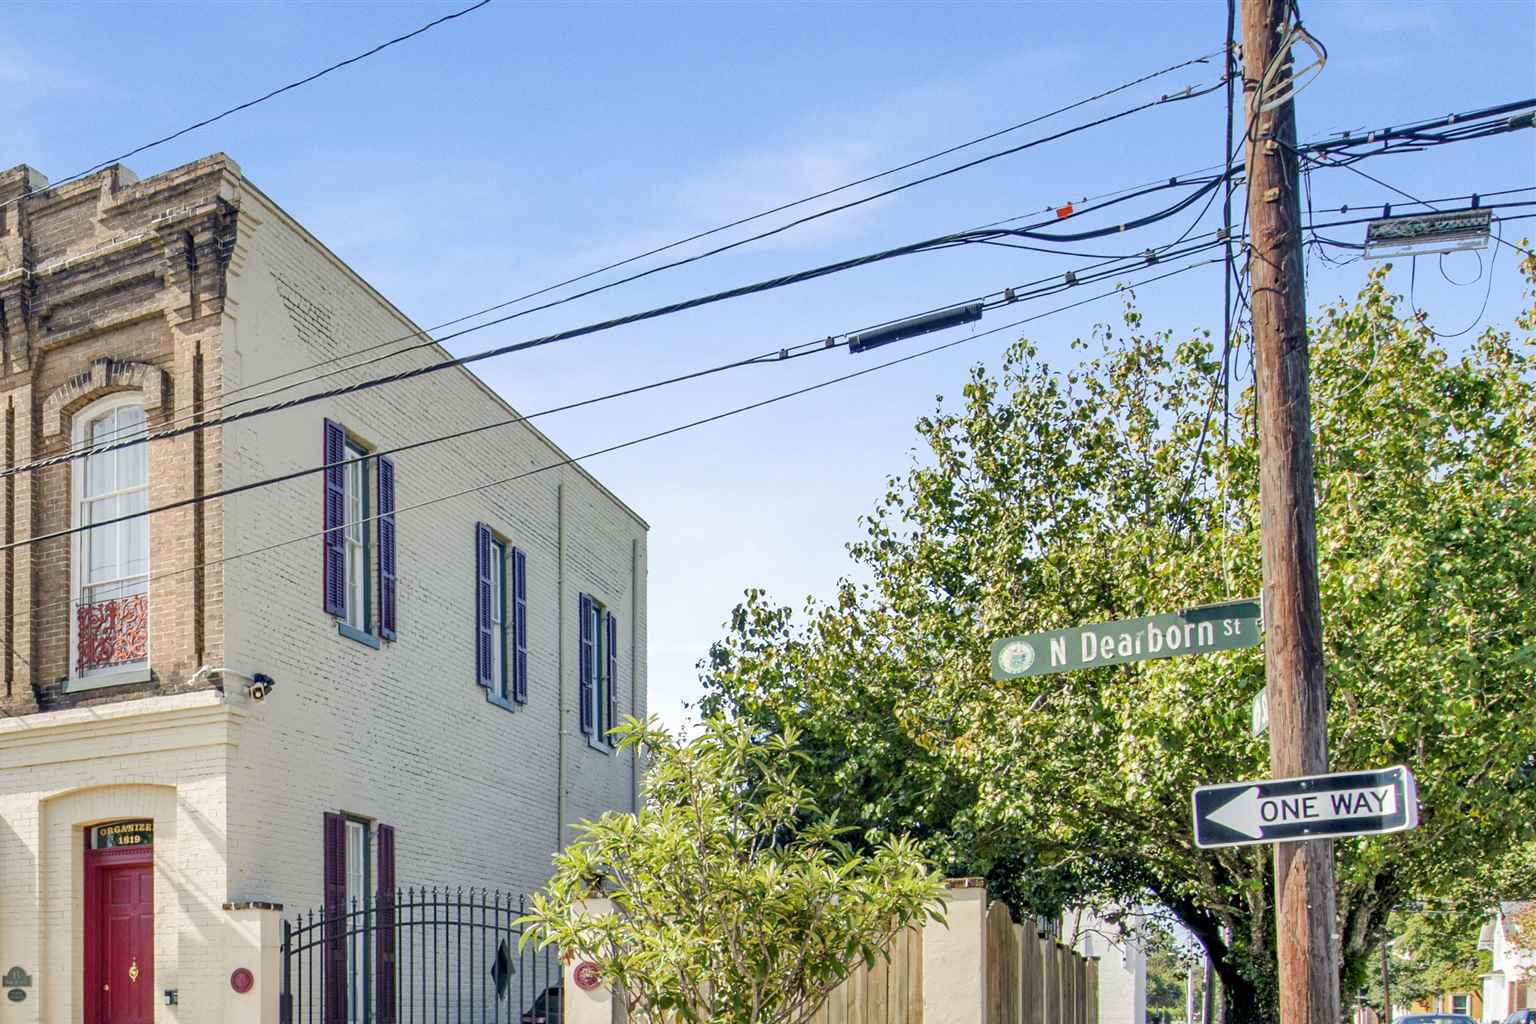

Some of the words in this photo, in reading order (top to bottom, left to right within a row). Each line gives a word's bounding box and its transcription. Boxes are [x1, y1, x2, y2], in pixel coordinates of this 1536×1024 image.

[1050, 637, 1067, 667] N
[1081, 621, 1214, 663] Dearborn
[1223, 618, 1241, 636] St
[1260, 796, 1318, 822] ONE
[1330, 789, 1389, 815] WAY
